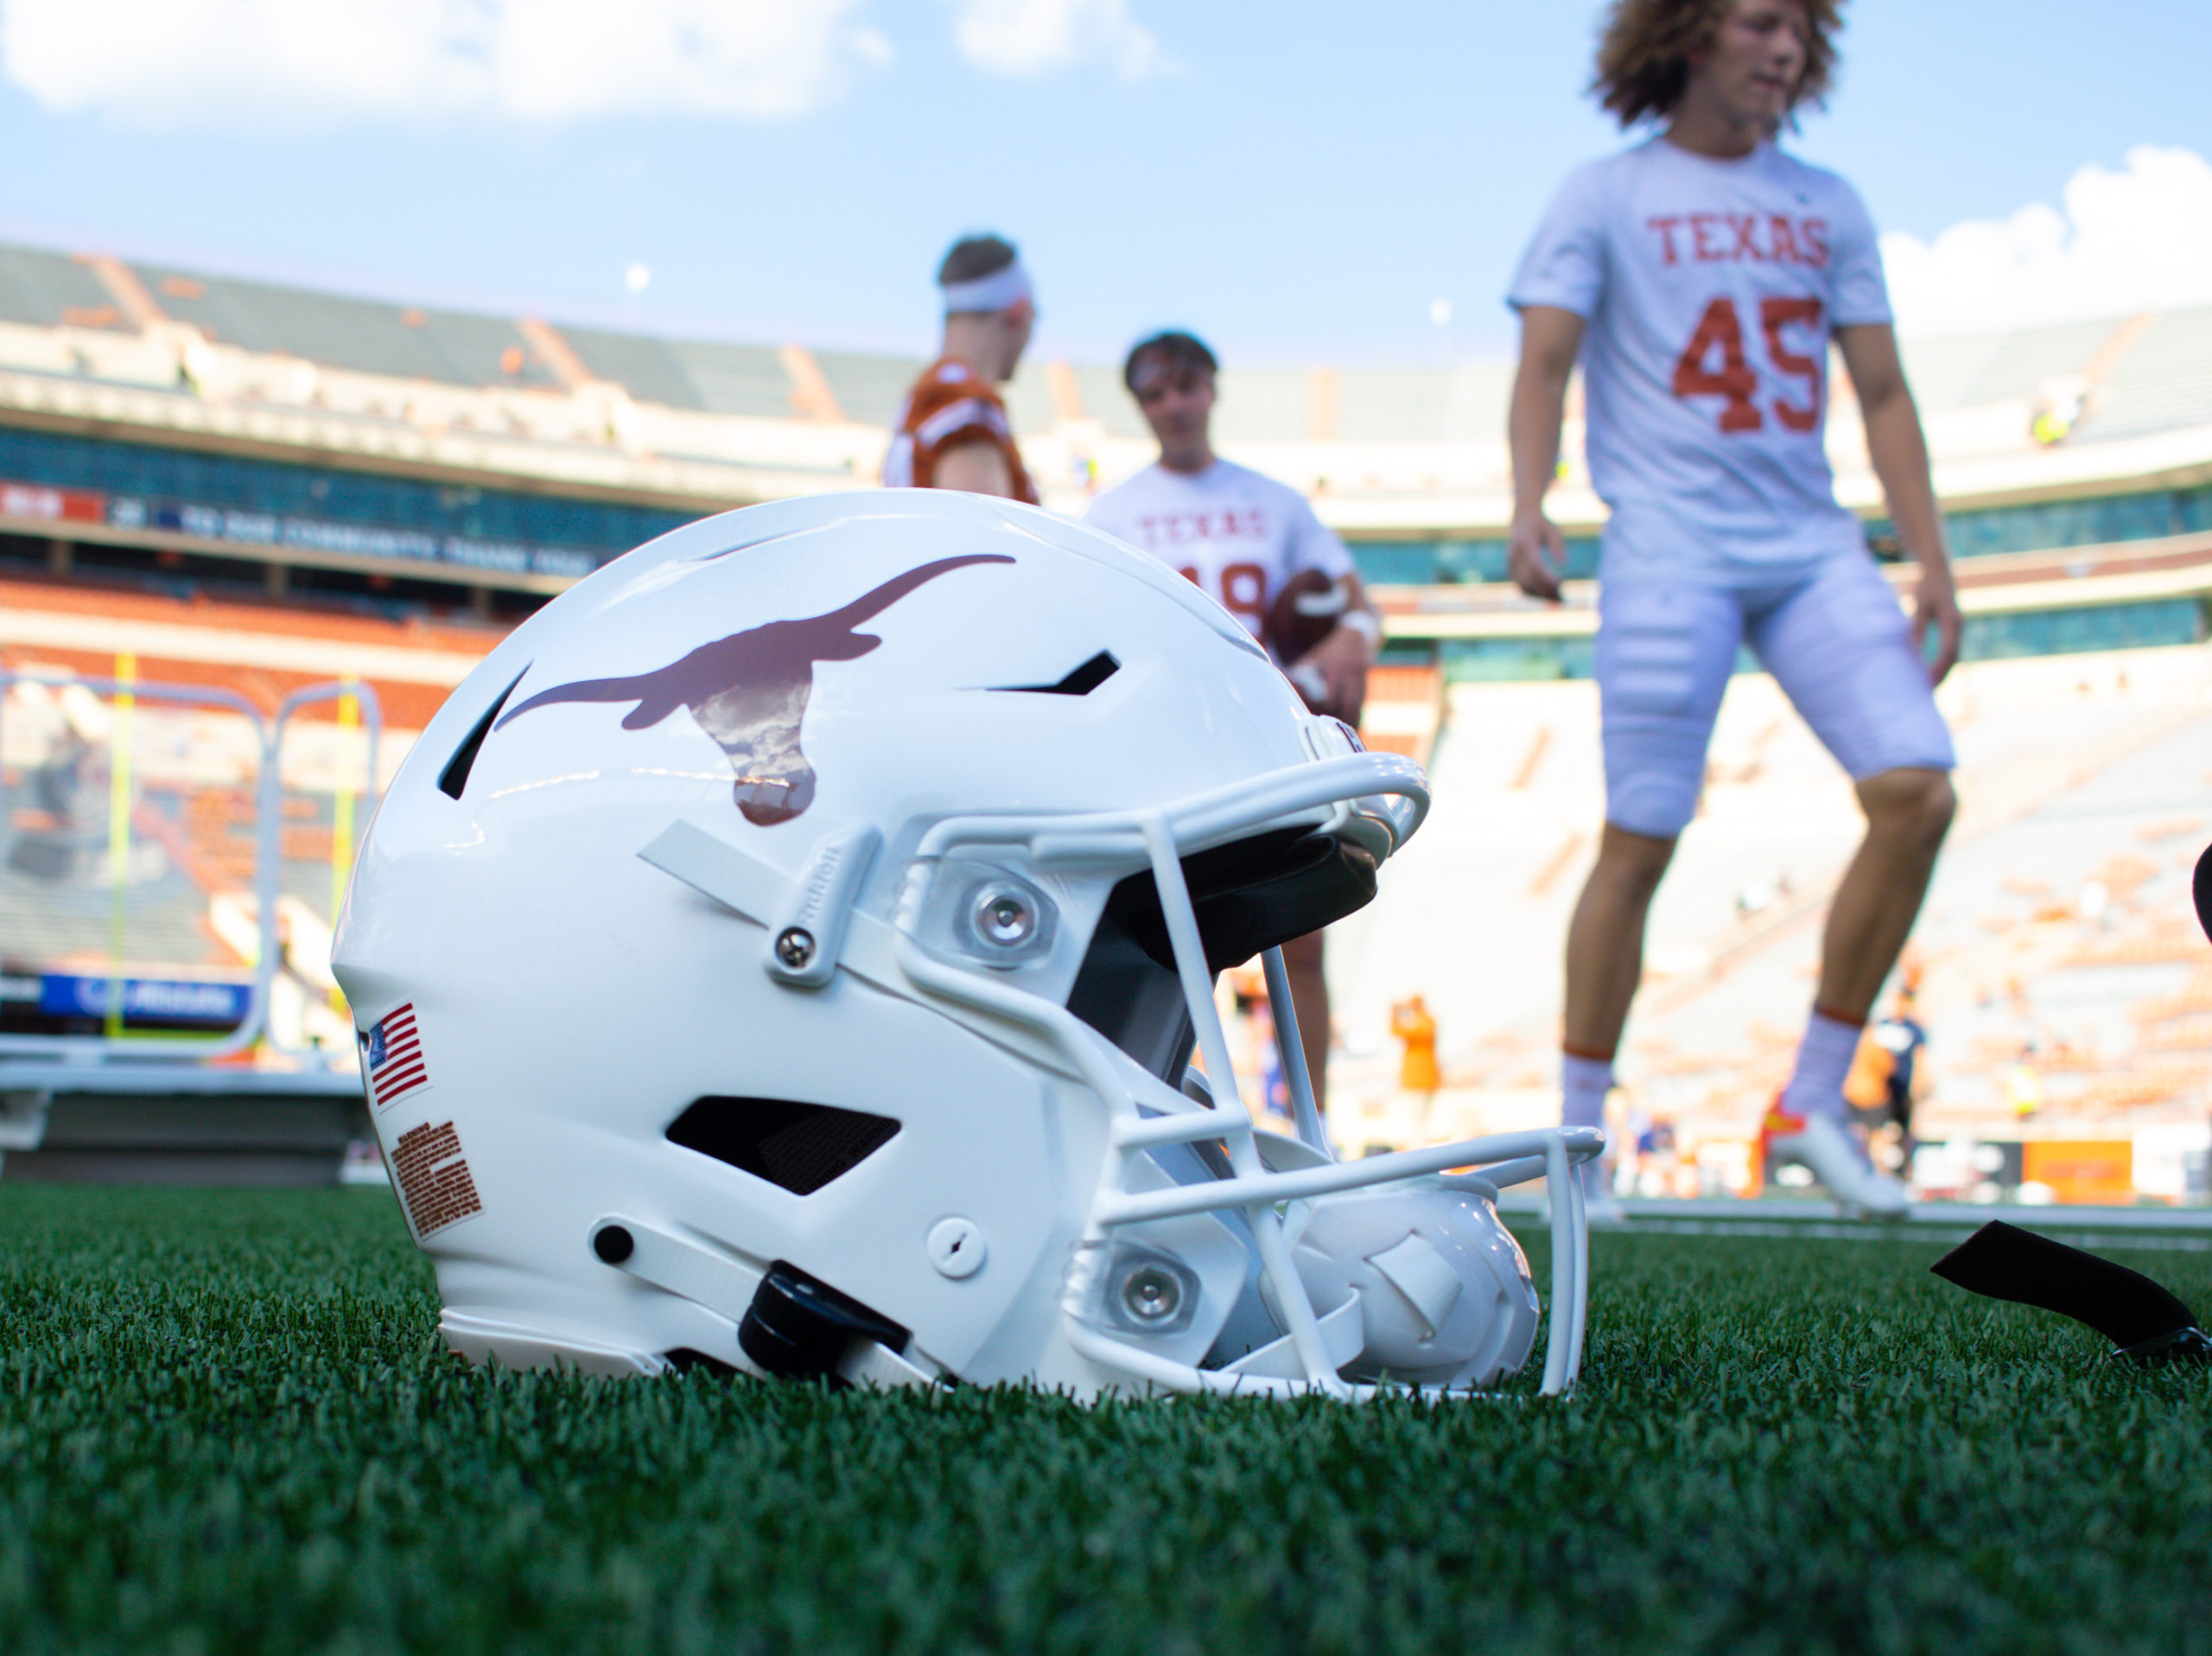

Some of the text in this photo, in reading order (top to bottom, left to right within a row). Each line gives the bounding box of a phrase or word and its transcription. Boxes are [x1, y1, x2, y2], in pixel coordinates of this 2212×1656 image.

[1646, 213, 1830, 268] TEXAS
[1673, 295, 1822, 434] 45
[1138, 510, 1267, 545] TEXAS
